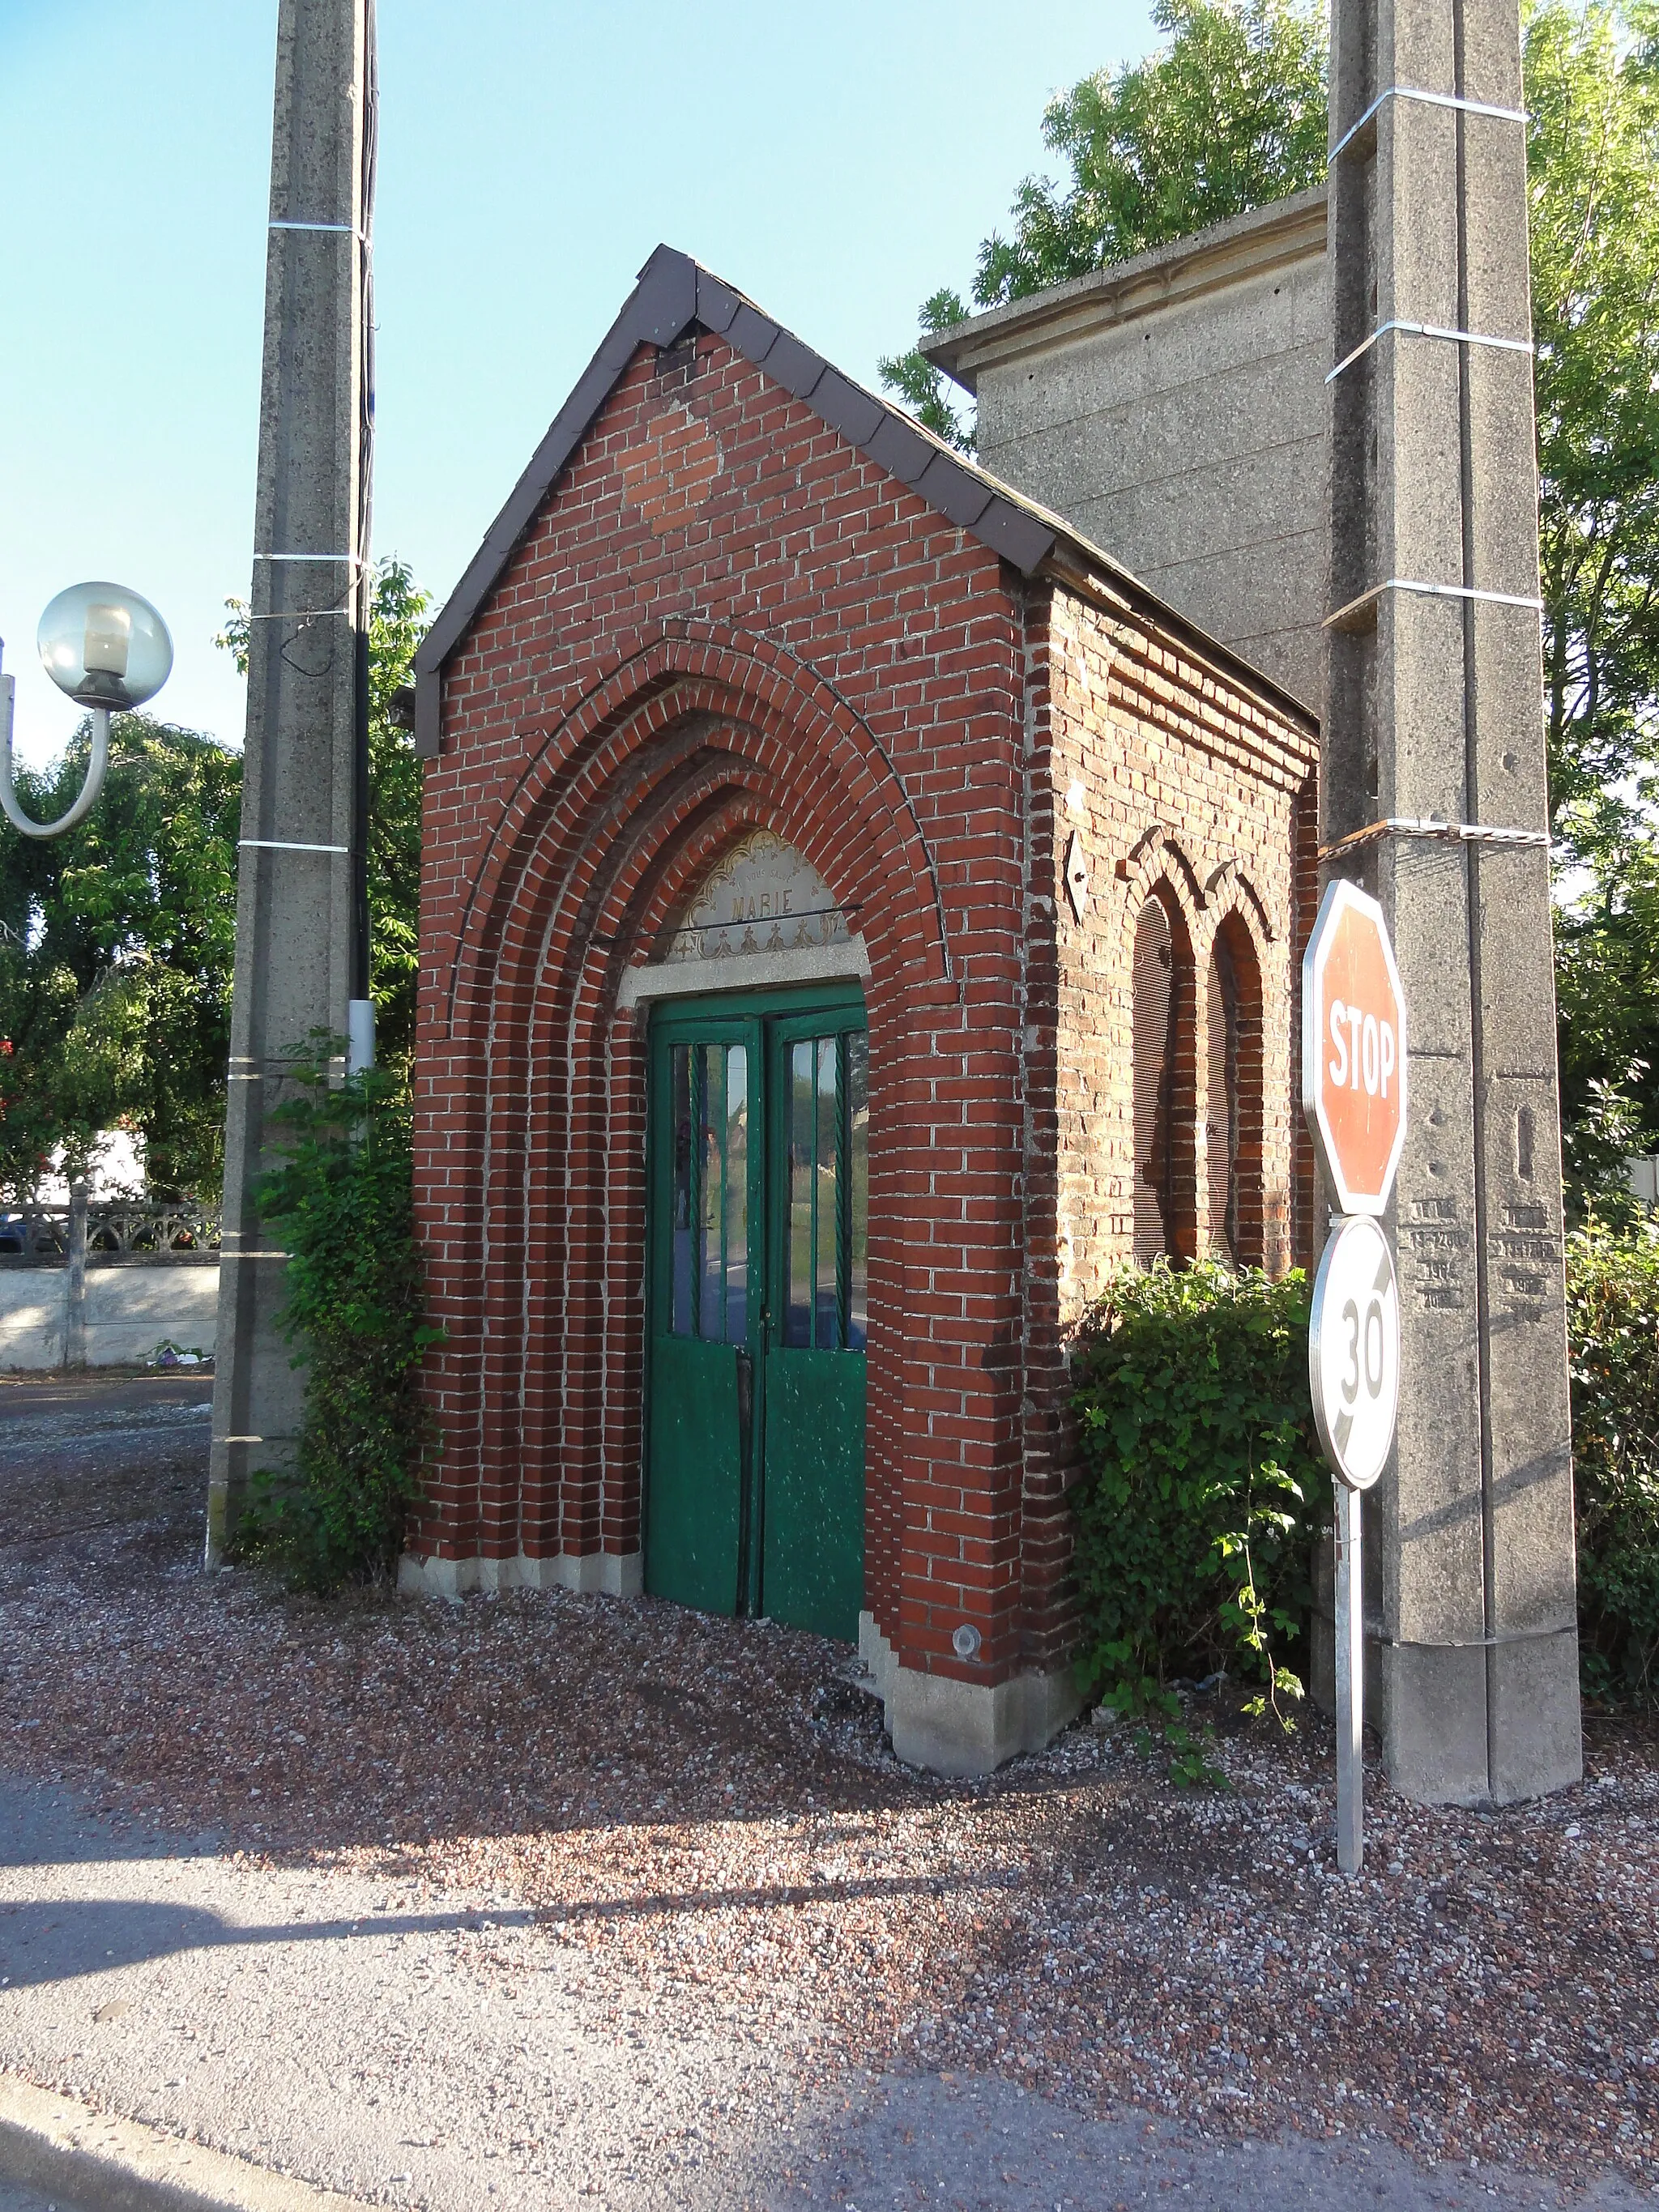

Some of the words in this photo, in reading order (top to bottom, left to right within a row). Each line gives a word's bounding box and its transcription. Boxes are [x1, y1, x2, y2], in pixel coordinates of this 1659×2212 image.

[731, 889, 793, 921] MARIE
[1328, 998, 1395, 1098] STOP
[1341, 1298, 1383, 1405] 30
